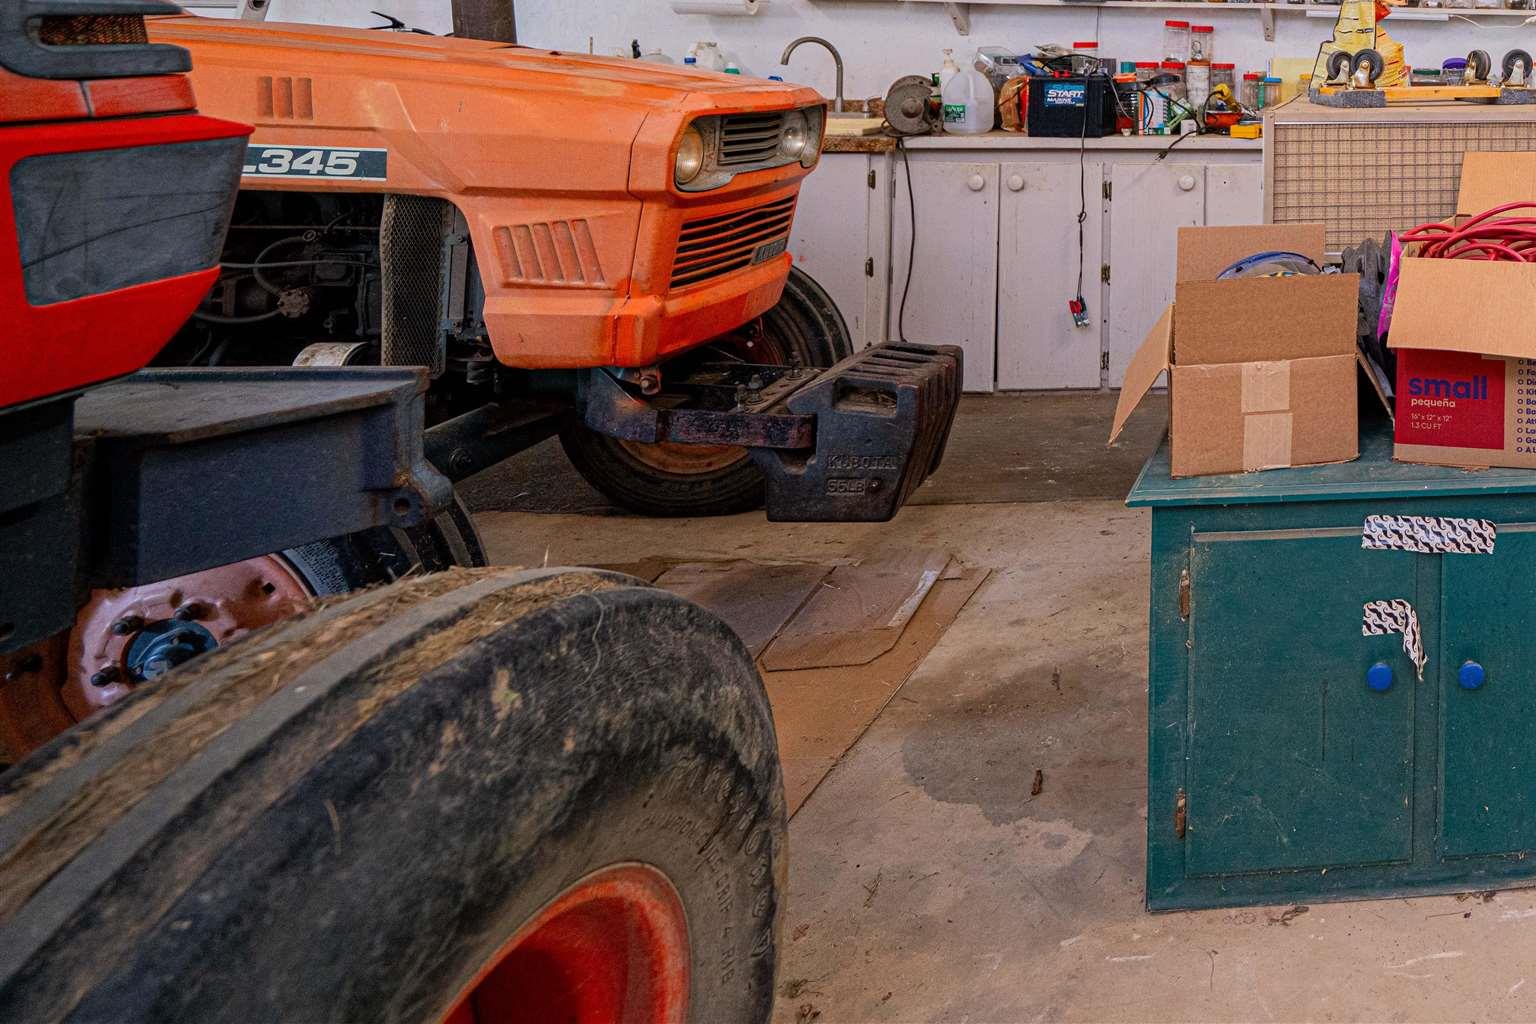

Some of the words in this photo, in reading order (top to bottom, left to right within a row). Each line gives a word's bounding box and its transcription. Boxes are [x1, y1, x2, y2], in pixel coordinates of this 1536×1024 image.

[242, 149, 360, 176] 345
[1408, 375, 1488, 400] small
[1411, 399, 1456, 408] pequeña
[827, 456, 898, 469] KUBOTA
